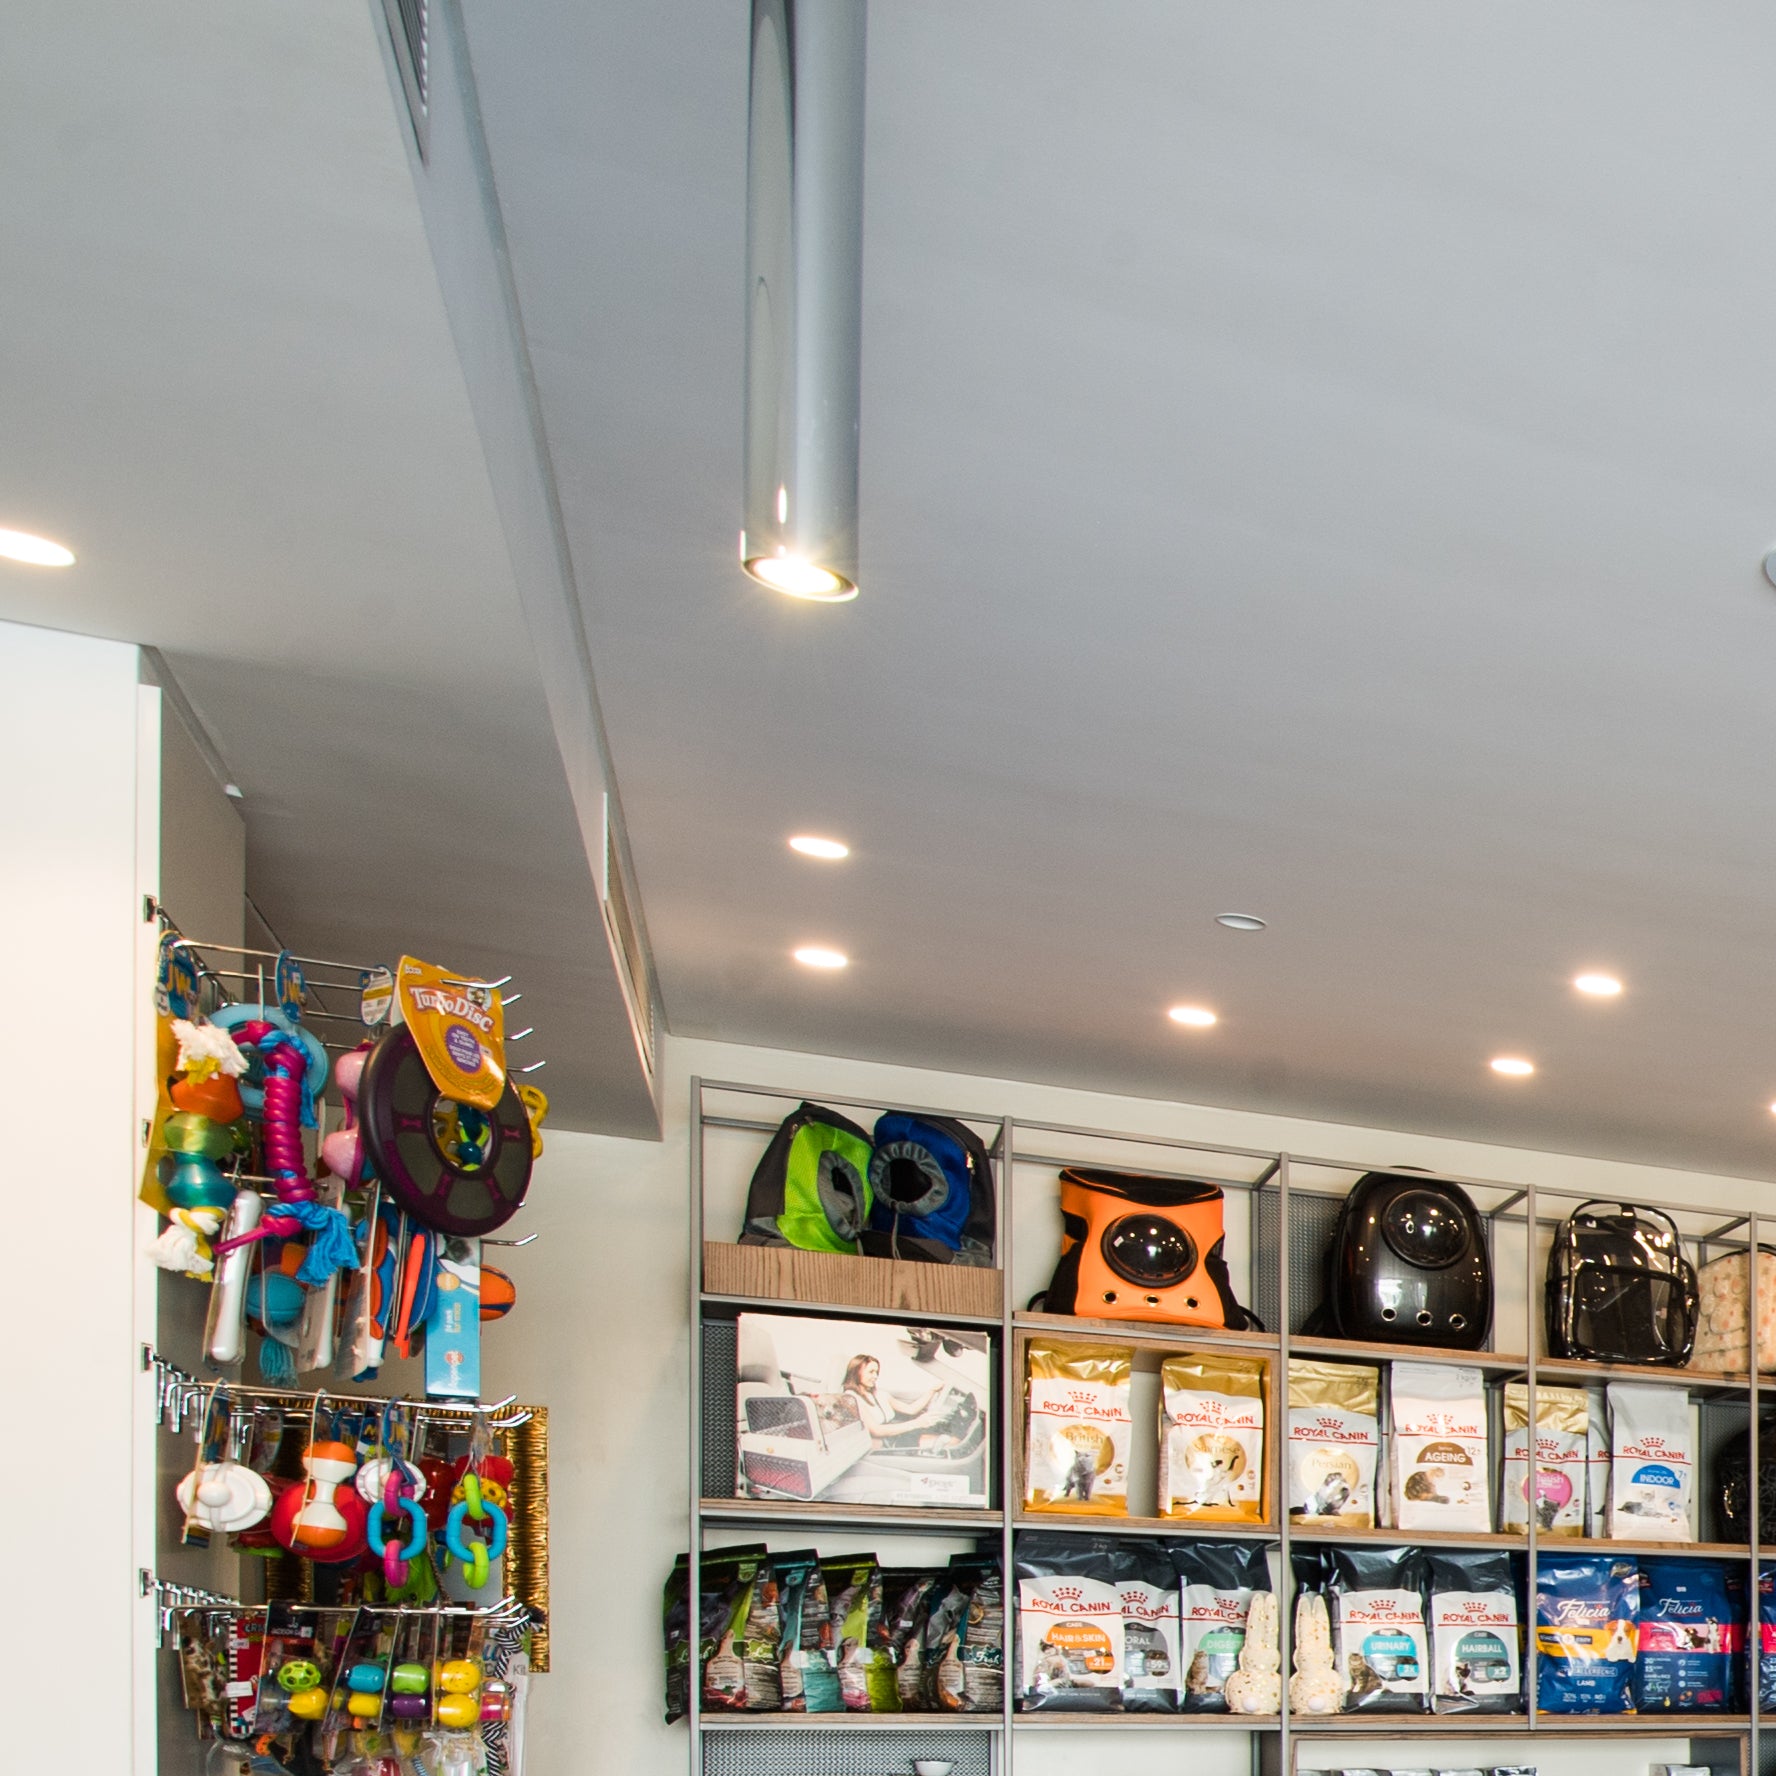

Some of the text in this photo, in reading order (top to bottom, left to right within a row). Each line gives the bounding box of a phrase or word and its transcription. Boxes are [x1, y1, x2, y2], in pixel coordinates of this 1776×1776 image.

[1066, 1432, 1104, 1444] British
[1293, 1426, 1369, 1441] ROYAL CANIN
[1424, 1451, 1466, 1463] AGEING
[1515, 1448, 1545, 1459] ROAL
[1623, 1446, 1686, 1460] ROYAL CANIN
[1311, 1458, 1352, 1471] Persian
[1639, 1474, 1675, 1486] INDOOR
[1032, 1599, 1111, 1613] ROYAL CANIN
[1133, 1605, 1169, 1617] CANIN
[1557, 1599, 1611, 1621] Felicia
[1657, 1598, 1704, 1617] Felicia
[1192, 1606, 1226, 1619] ROYAL
[1350, 1611, 1420, 1624] ROYAL CANIN
[1442, 1613, 1509, 1624] ROYAL CANIN
[1371, 1641, 1410, 1651] URINARY
[1461, 1643, 1502, 1654] HAIRBALL
